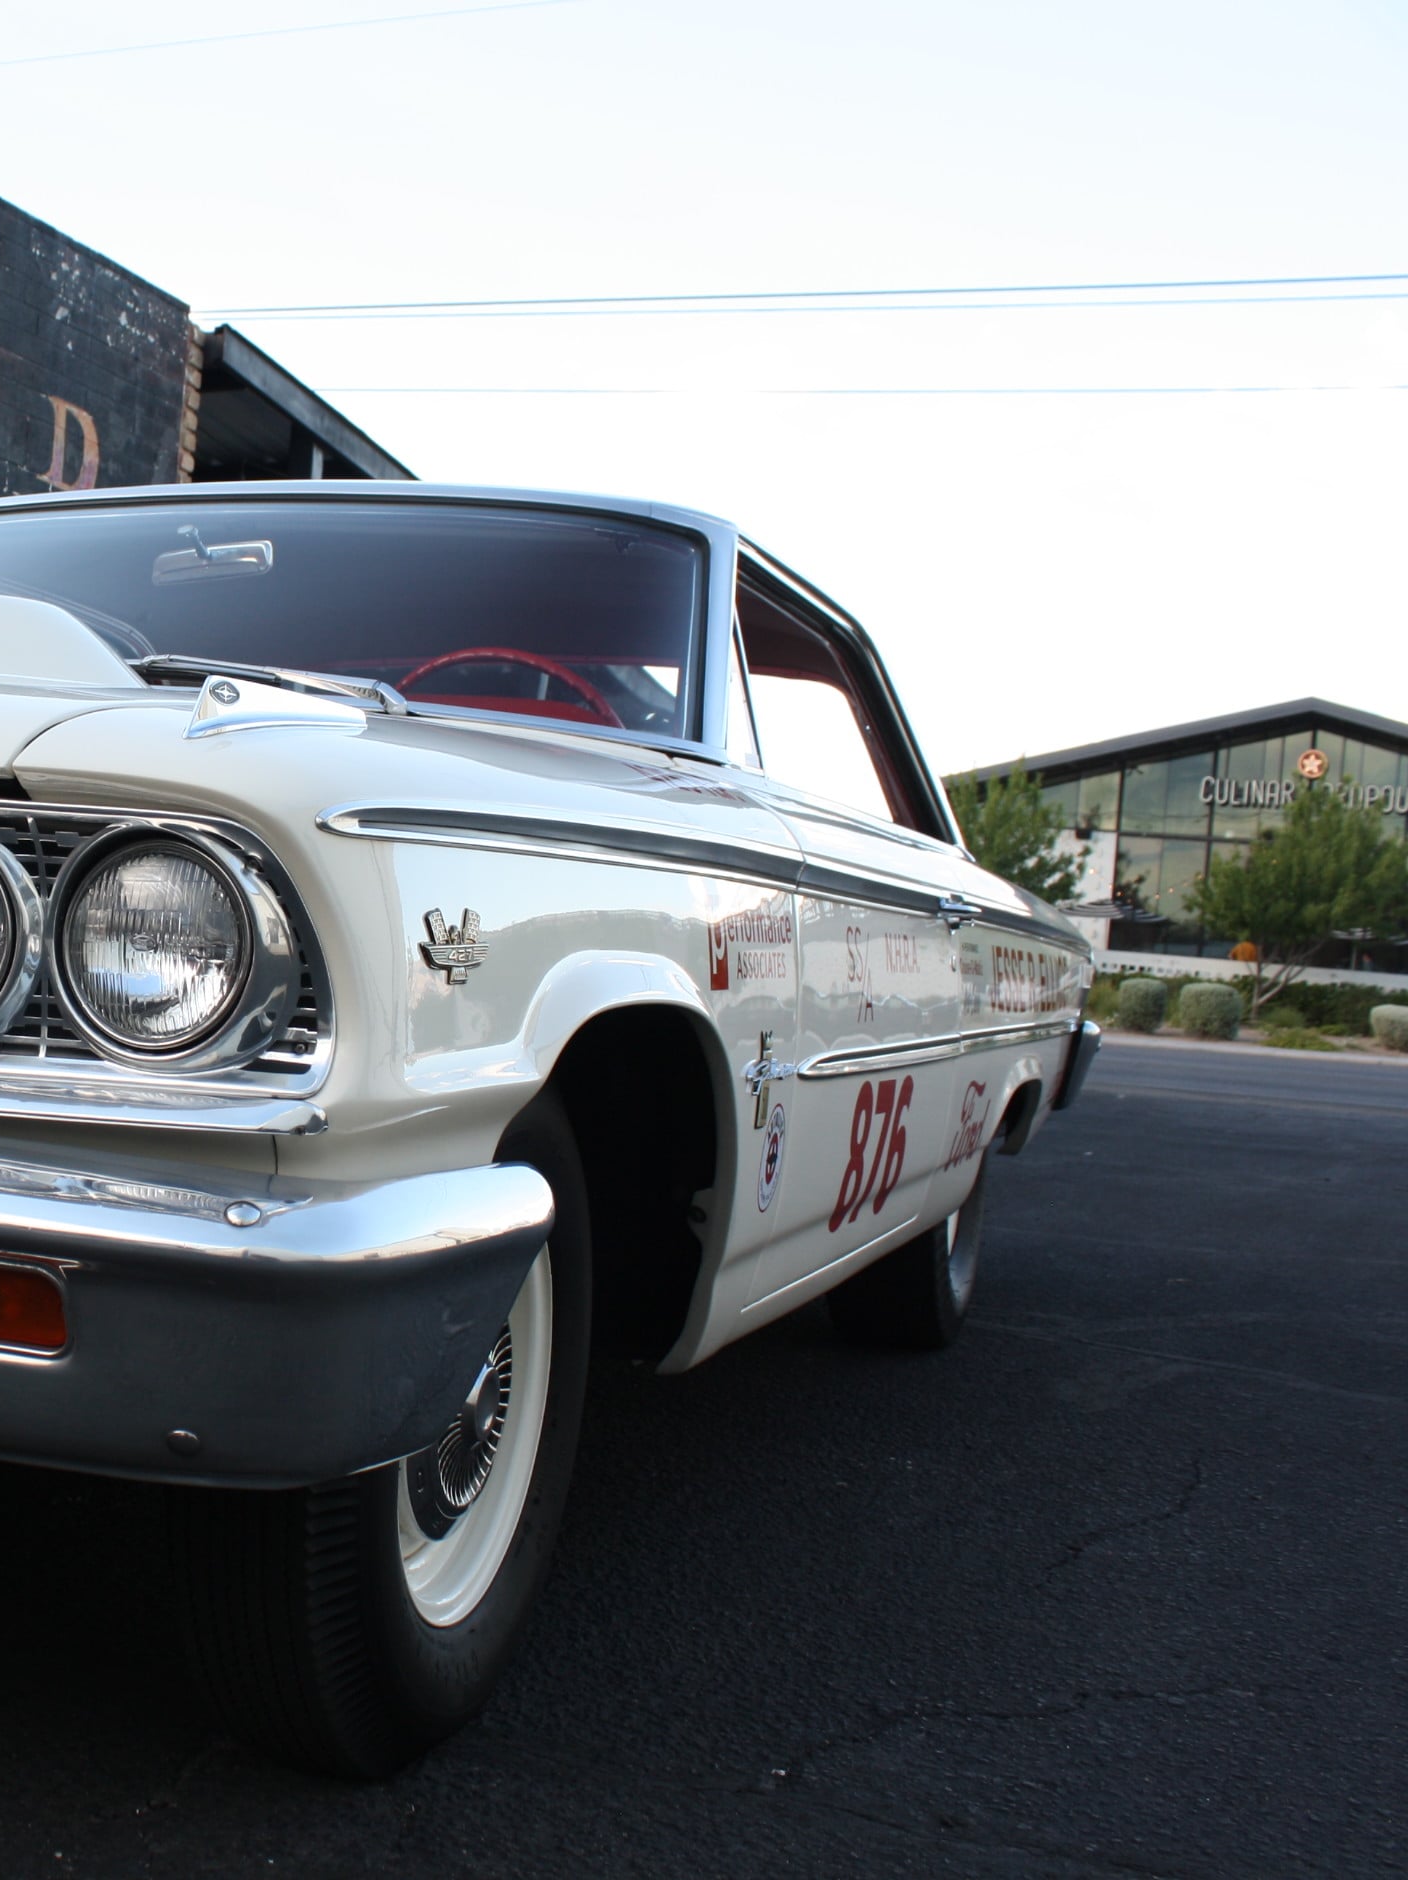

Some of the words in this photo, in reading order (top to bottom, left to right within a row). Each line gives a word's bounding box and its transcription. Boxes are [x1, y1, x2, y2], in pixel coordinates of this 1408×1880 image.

[1199, 775, 1296, 808] CULINAR
[448, 949, 474, 962] 427
[736, 951, 787, 980] ASSOCIATES
[828, 1074, 914, 1233] 876
